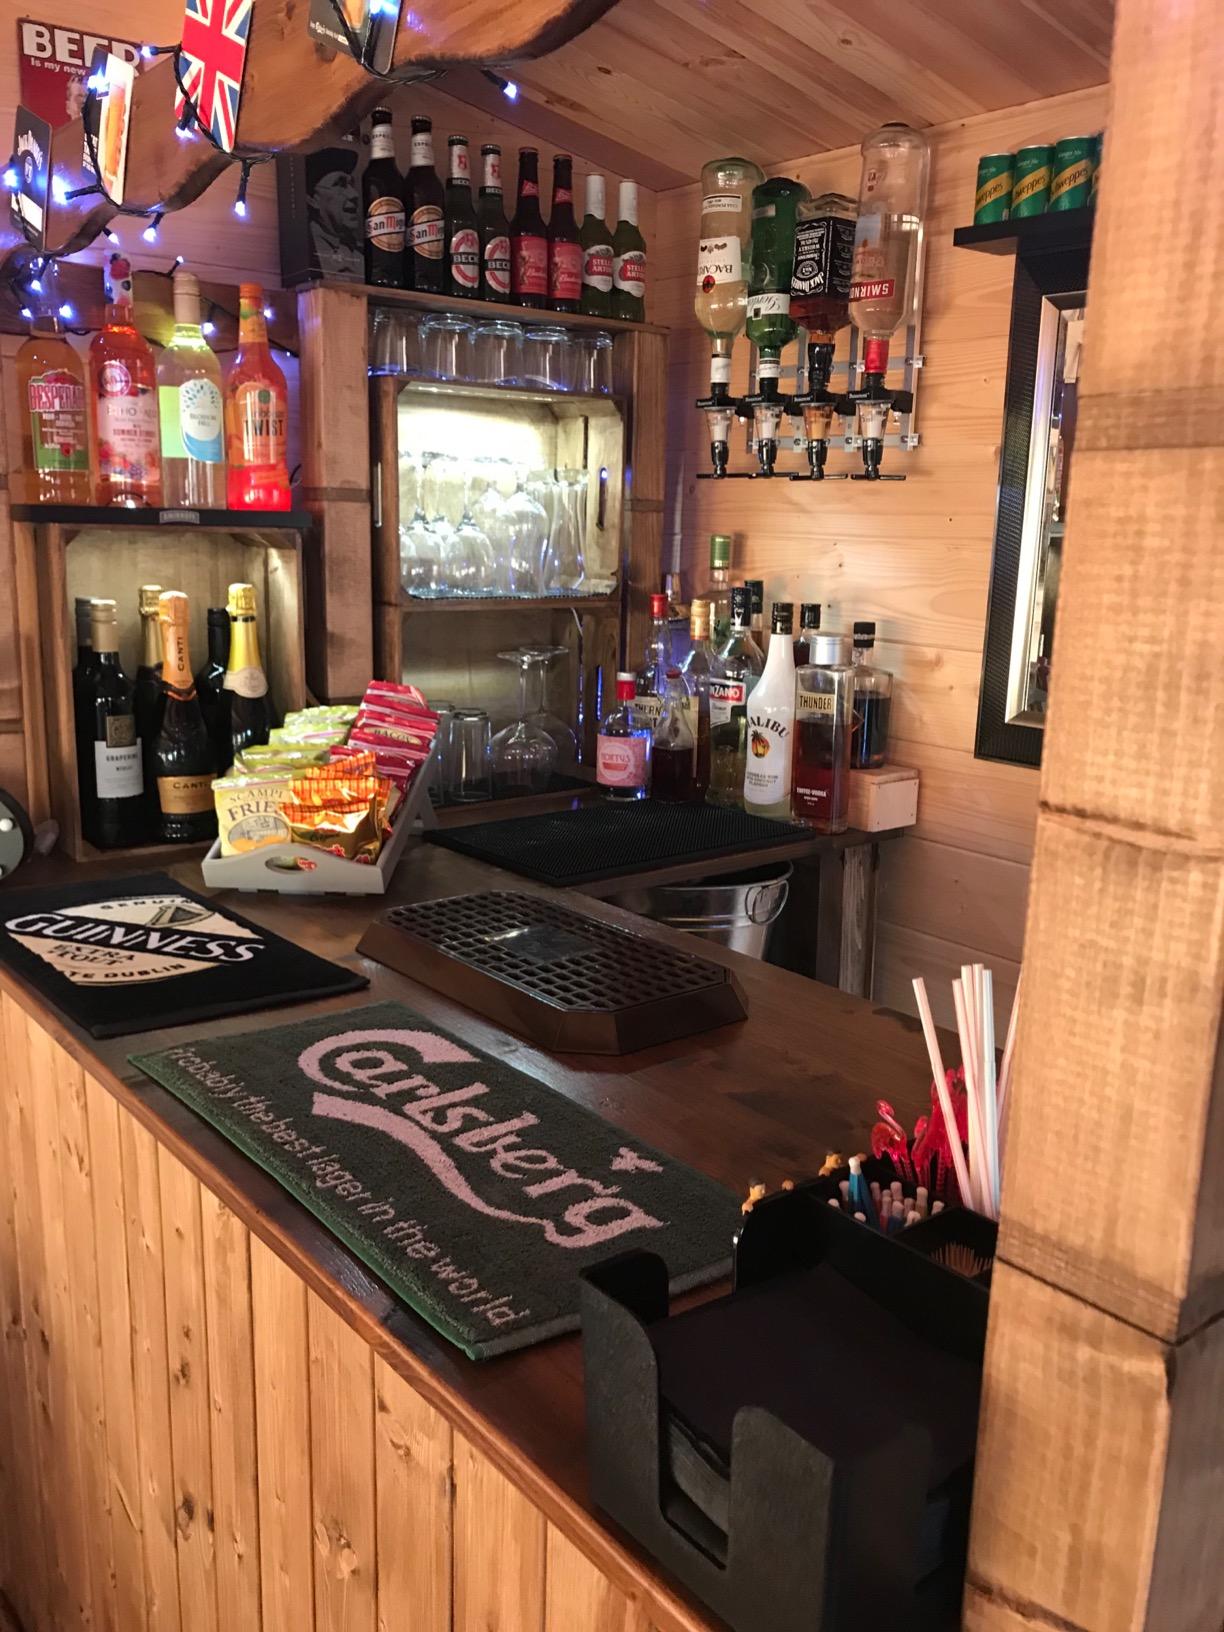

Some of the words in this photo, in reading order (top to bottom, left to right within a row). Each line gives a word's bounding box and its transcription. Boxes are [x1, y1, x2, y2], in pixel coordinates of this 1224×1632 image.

[44, 61, 61, 73] my
[63, 66, 86, 77] new
[367, 220, 385, 235] San
[408, 229, 427, 243] San
[178, 636, 187, 672] CANTI
[799, 695, 832, 711] THUNDER
[374, 729, 411, 743] BACON
[229, 788, 284, 803] SCAMPI
[5, 913, 265, 962] GUINNESS
[54, 944, 135, 961] EXTRA
[103, 963, 187, 979] DUBLIN
[298, 1029, 666, 1249] Carlsberg
[231, 1095, 274, 1123] the
[262, 1118, 327, 1157] best
[306, 1153, 372, 1201] lager
[357, 1197, 396, 1223] in
[383, 1219, 441, 1259] the
[430, 1256, 531, 1327] world
